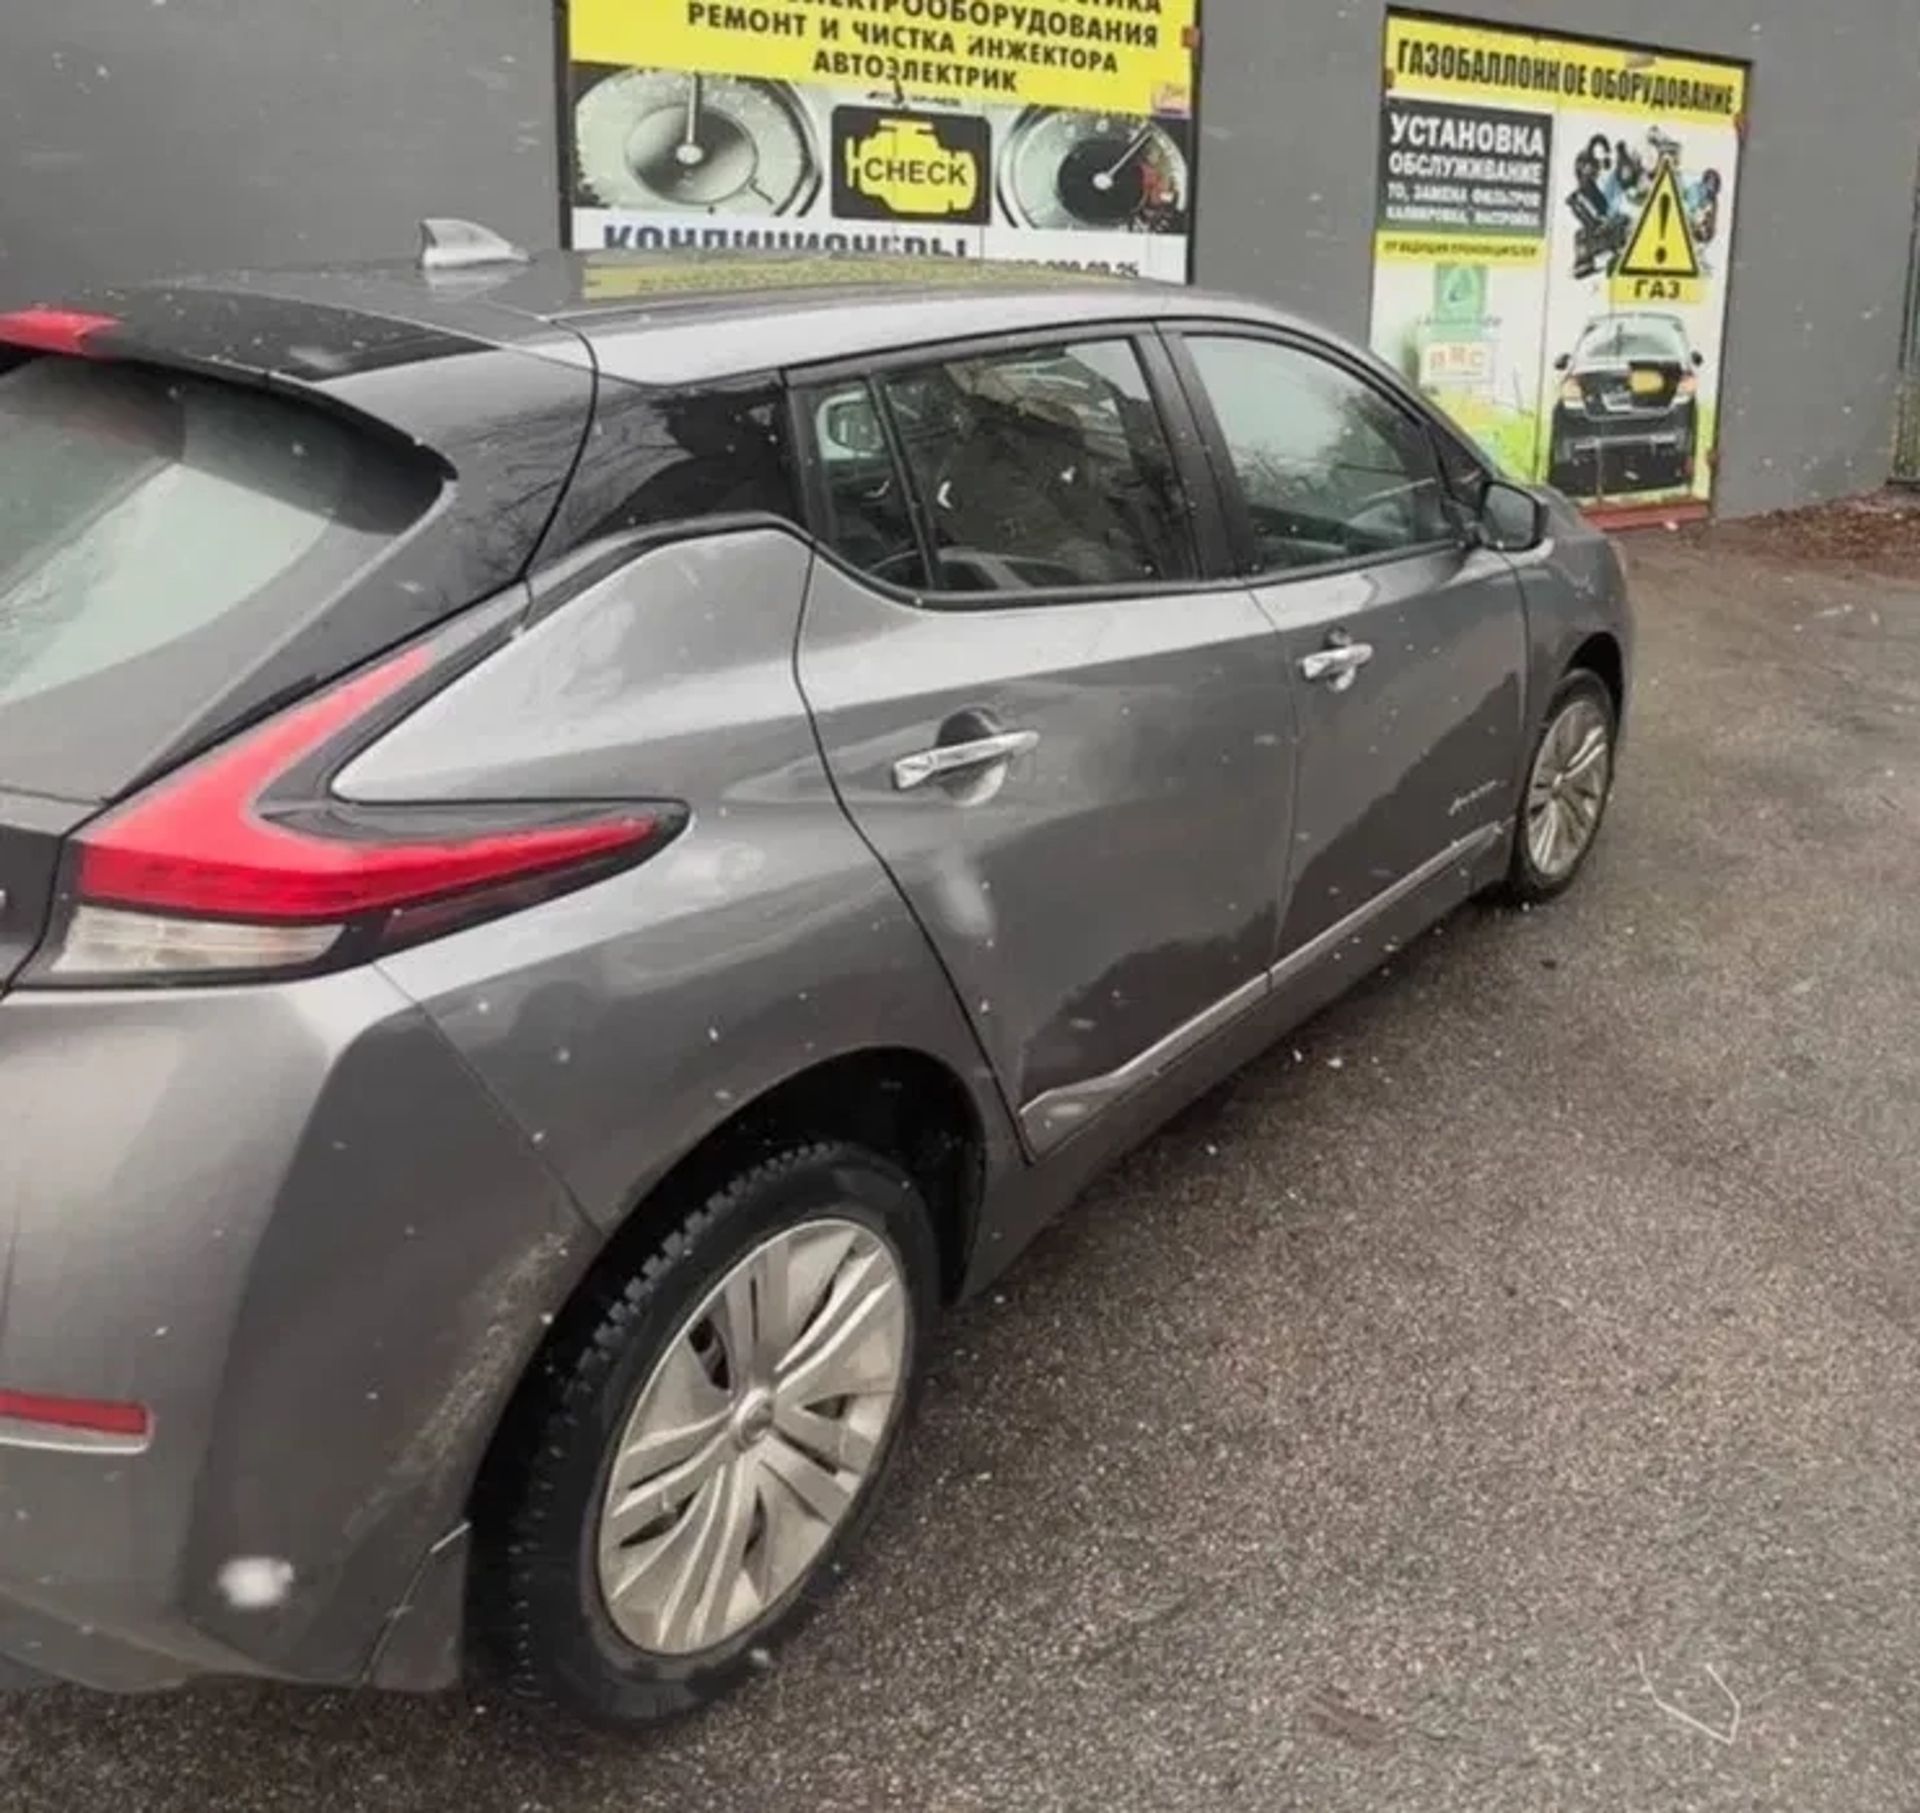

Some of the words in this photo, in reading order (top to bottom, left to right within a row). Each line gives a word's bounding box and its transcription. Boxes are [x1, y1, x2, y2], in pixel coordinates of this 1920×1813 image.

[687, 2, 807, 38] РЕМОНТ
[820, 17, 840, 41] И
[851, 19, 955, 55] ЧИСТКА
[967, 34, 1119, 74] ИНЖЕКТОРА
[812, 49, 1018, 93] АВТОЭЛЕКТРИК
[1589, 67, 1735, 116] ОБОРУДОВАНИЕ
[1389, 111, 1546, 158] УСТАНОВКА
[863, 156, 968, 188] CHECK
[1387, 150, 1544, 185] ОБСЛУЖИВАНИЕ
[1634, 278, 1681, 300] ГАЗ
